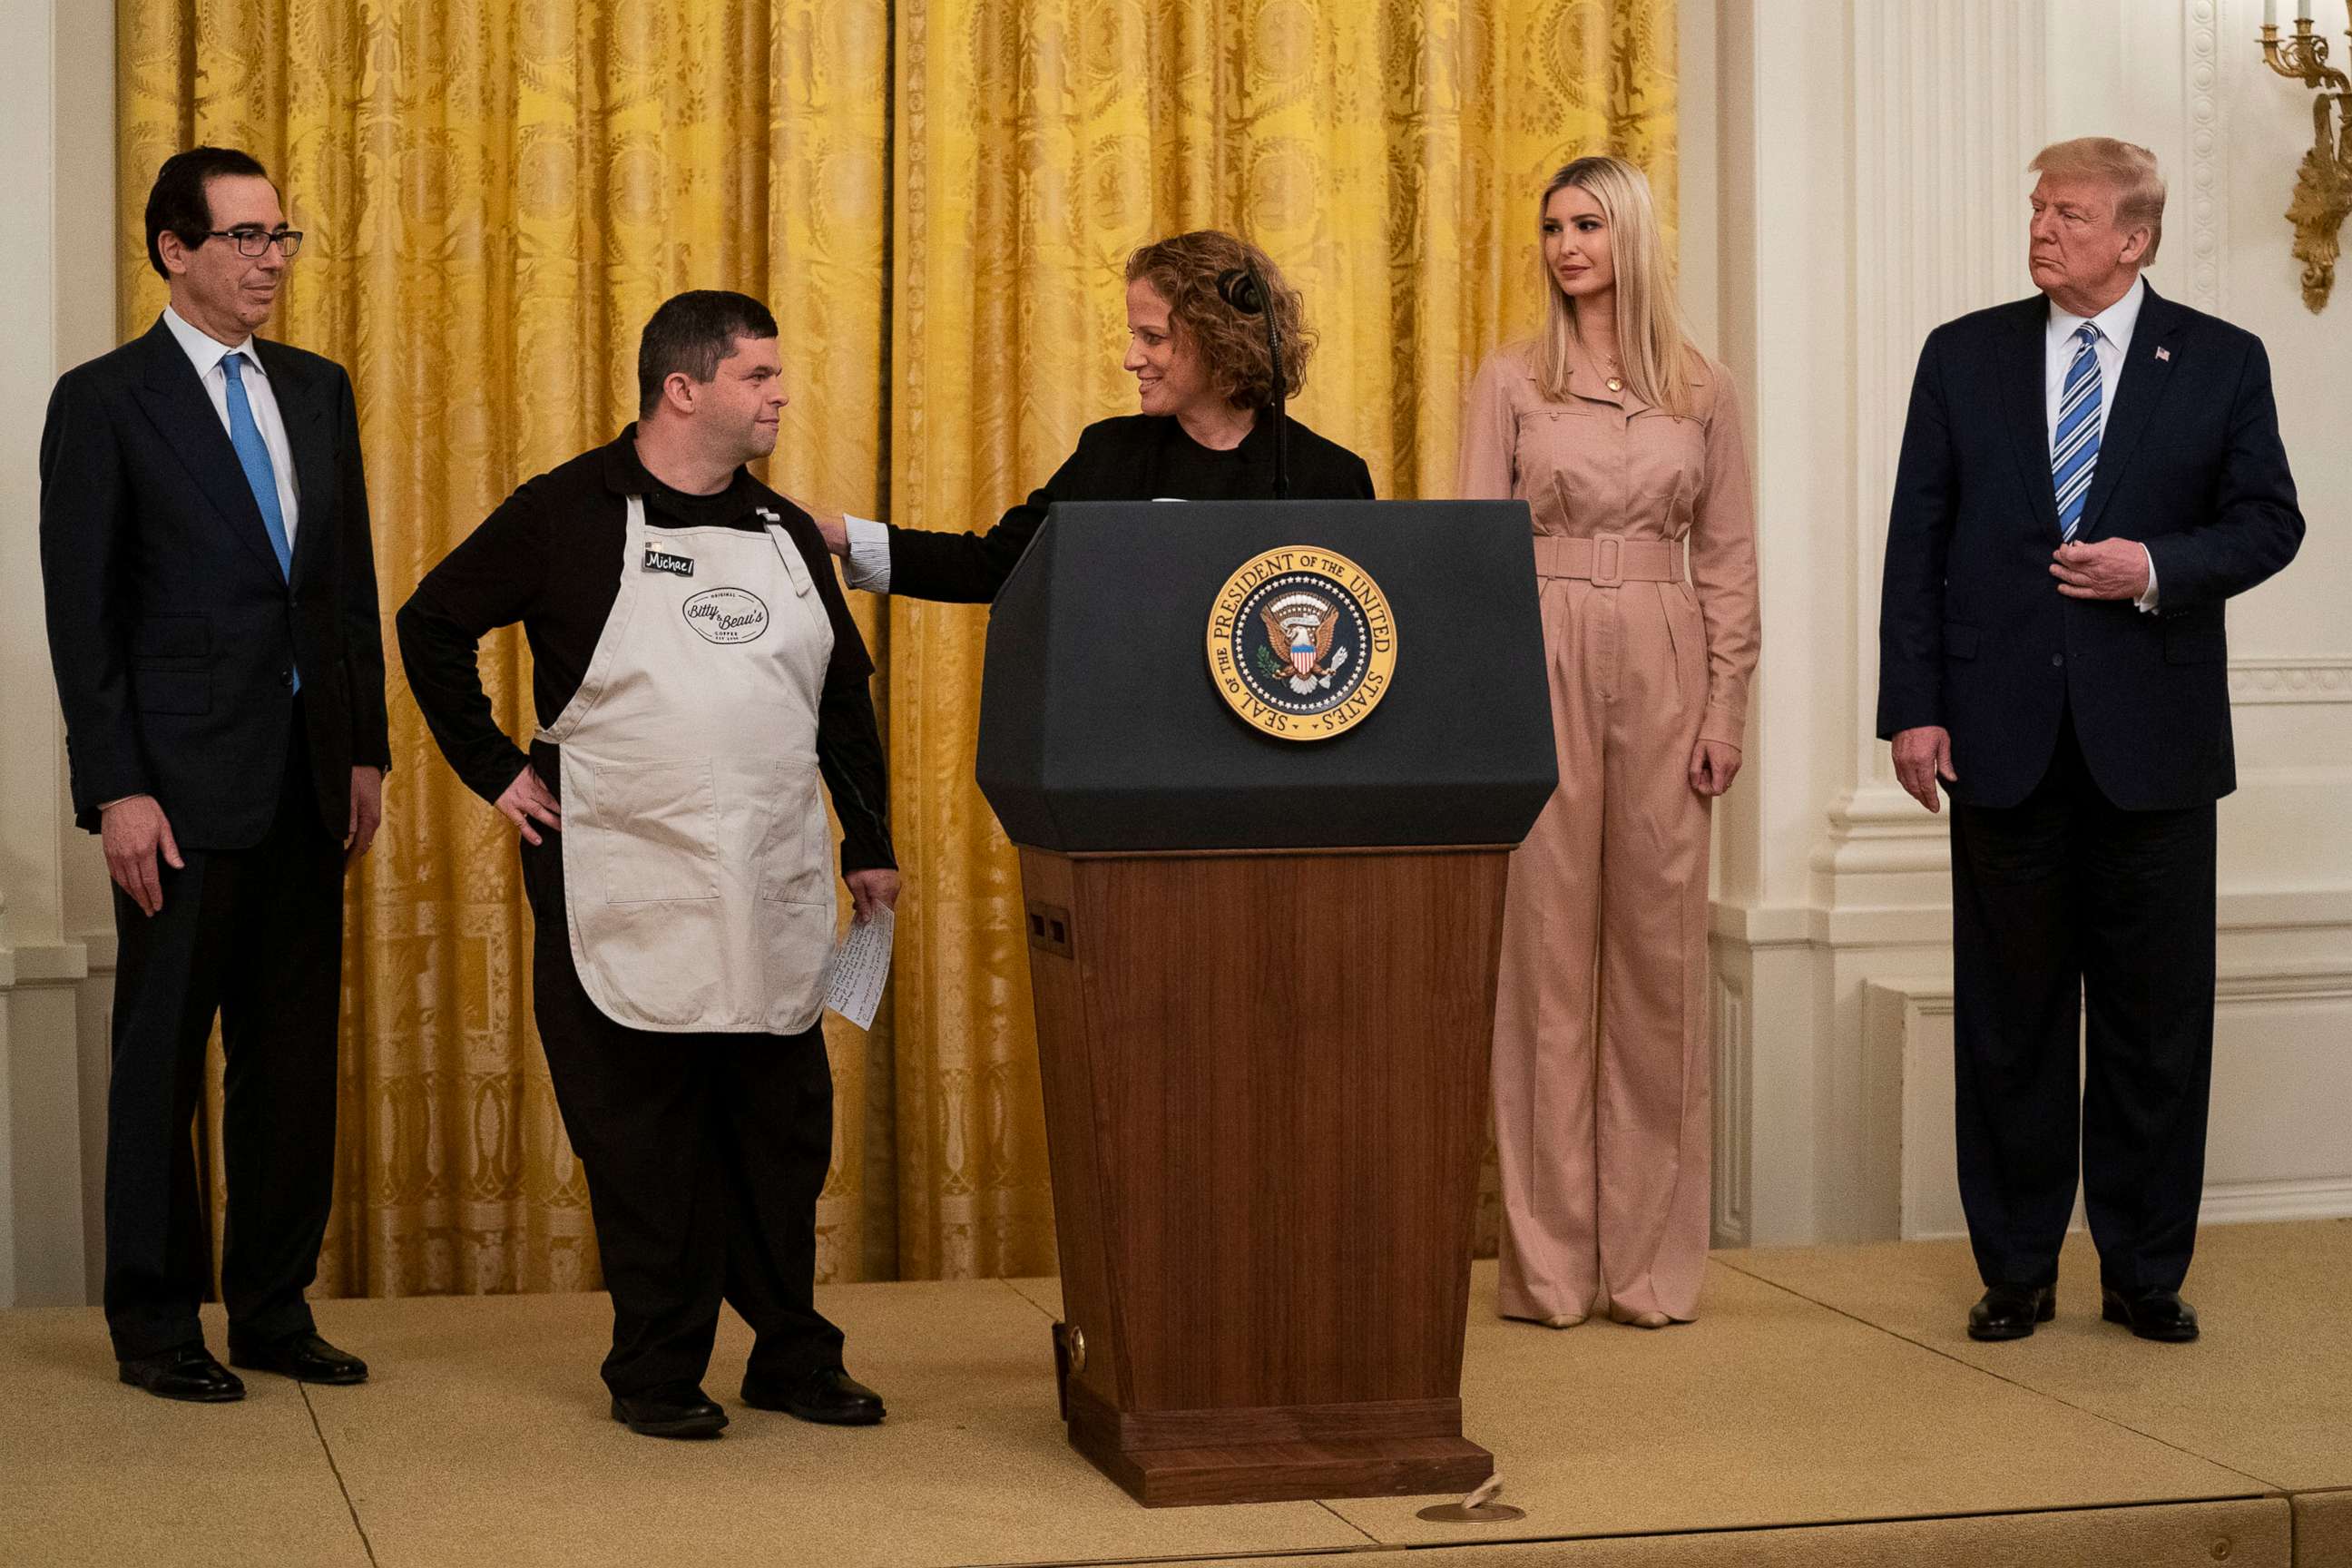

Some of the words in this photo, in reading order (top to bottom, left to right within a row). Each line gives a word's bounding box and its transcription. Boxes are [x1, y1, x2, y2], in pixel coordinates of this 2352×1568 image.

[646, 554, 693, 573] Michael
[1299, 555, 1318, 567] OF
[1321, 559, 1346, 577] THE
[1214, 554, 1294, 639] PRESIDENT
[688, 603, 719, 621] Bitty
[719, 609, 764, 631] Beau's
[1349, 577, 1390, 652] UNITED
[1216, 647, 1232, 673] THE
[1225, 677, 1240, 693] OF
[1240, 694, 1289, 730] SEAL
[1322, 671, 1384, 730] STATES
